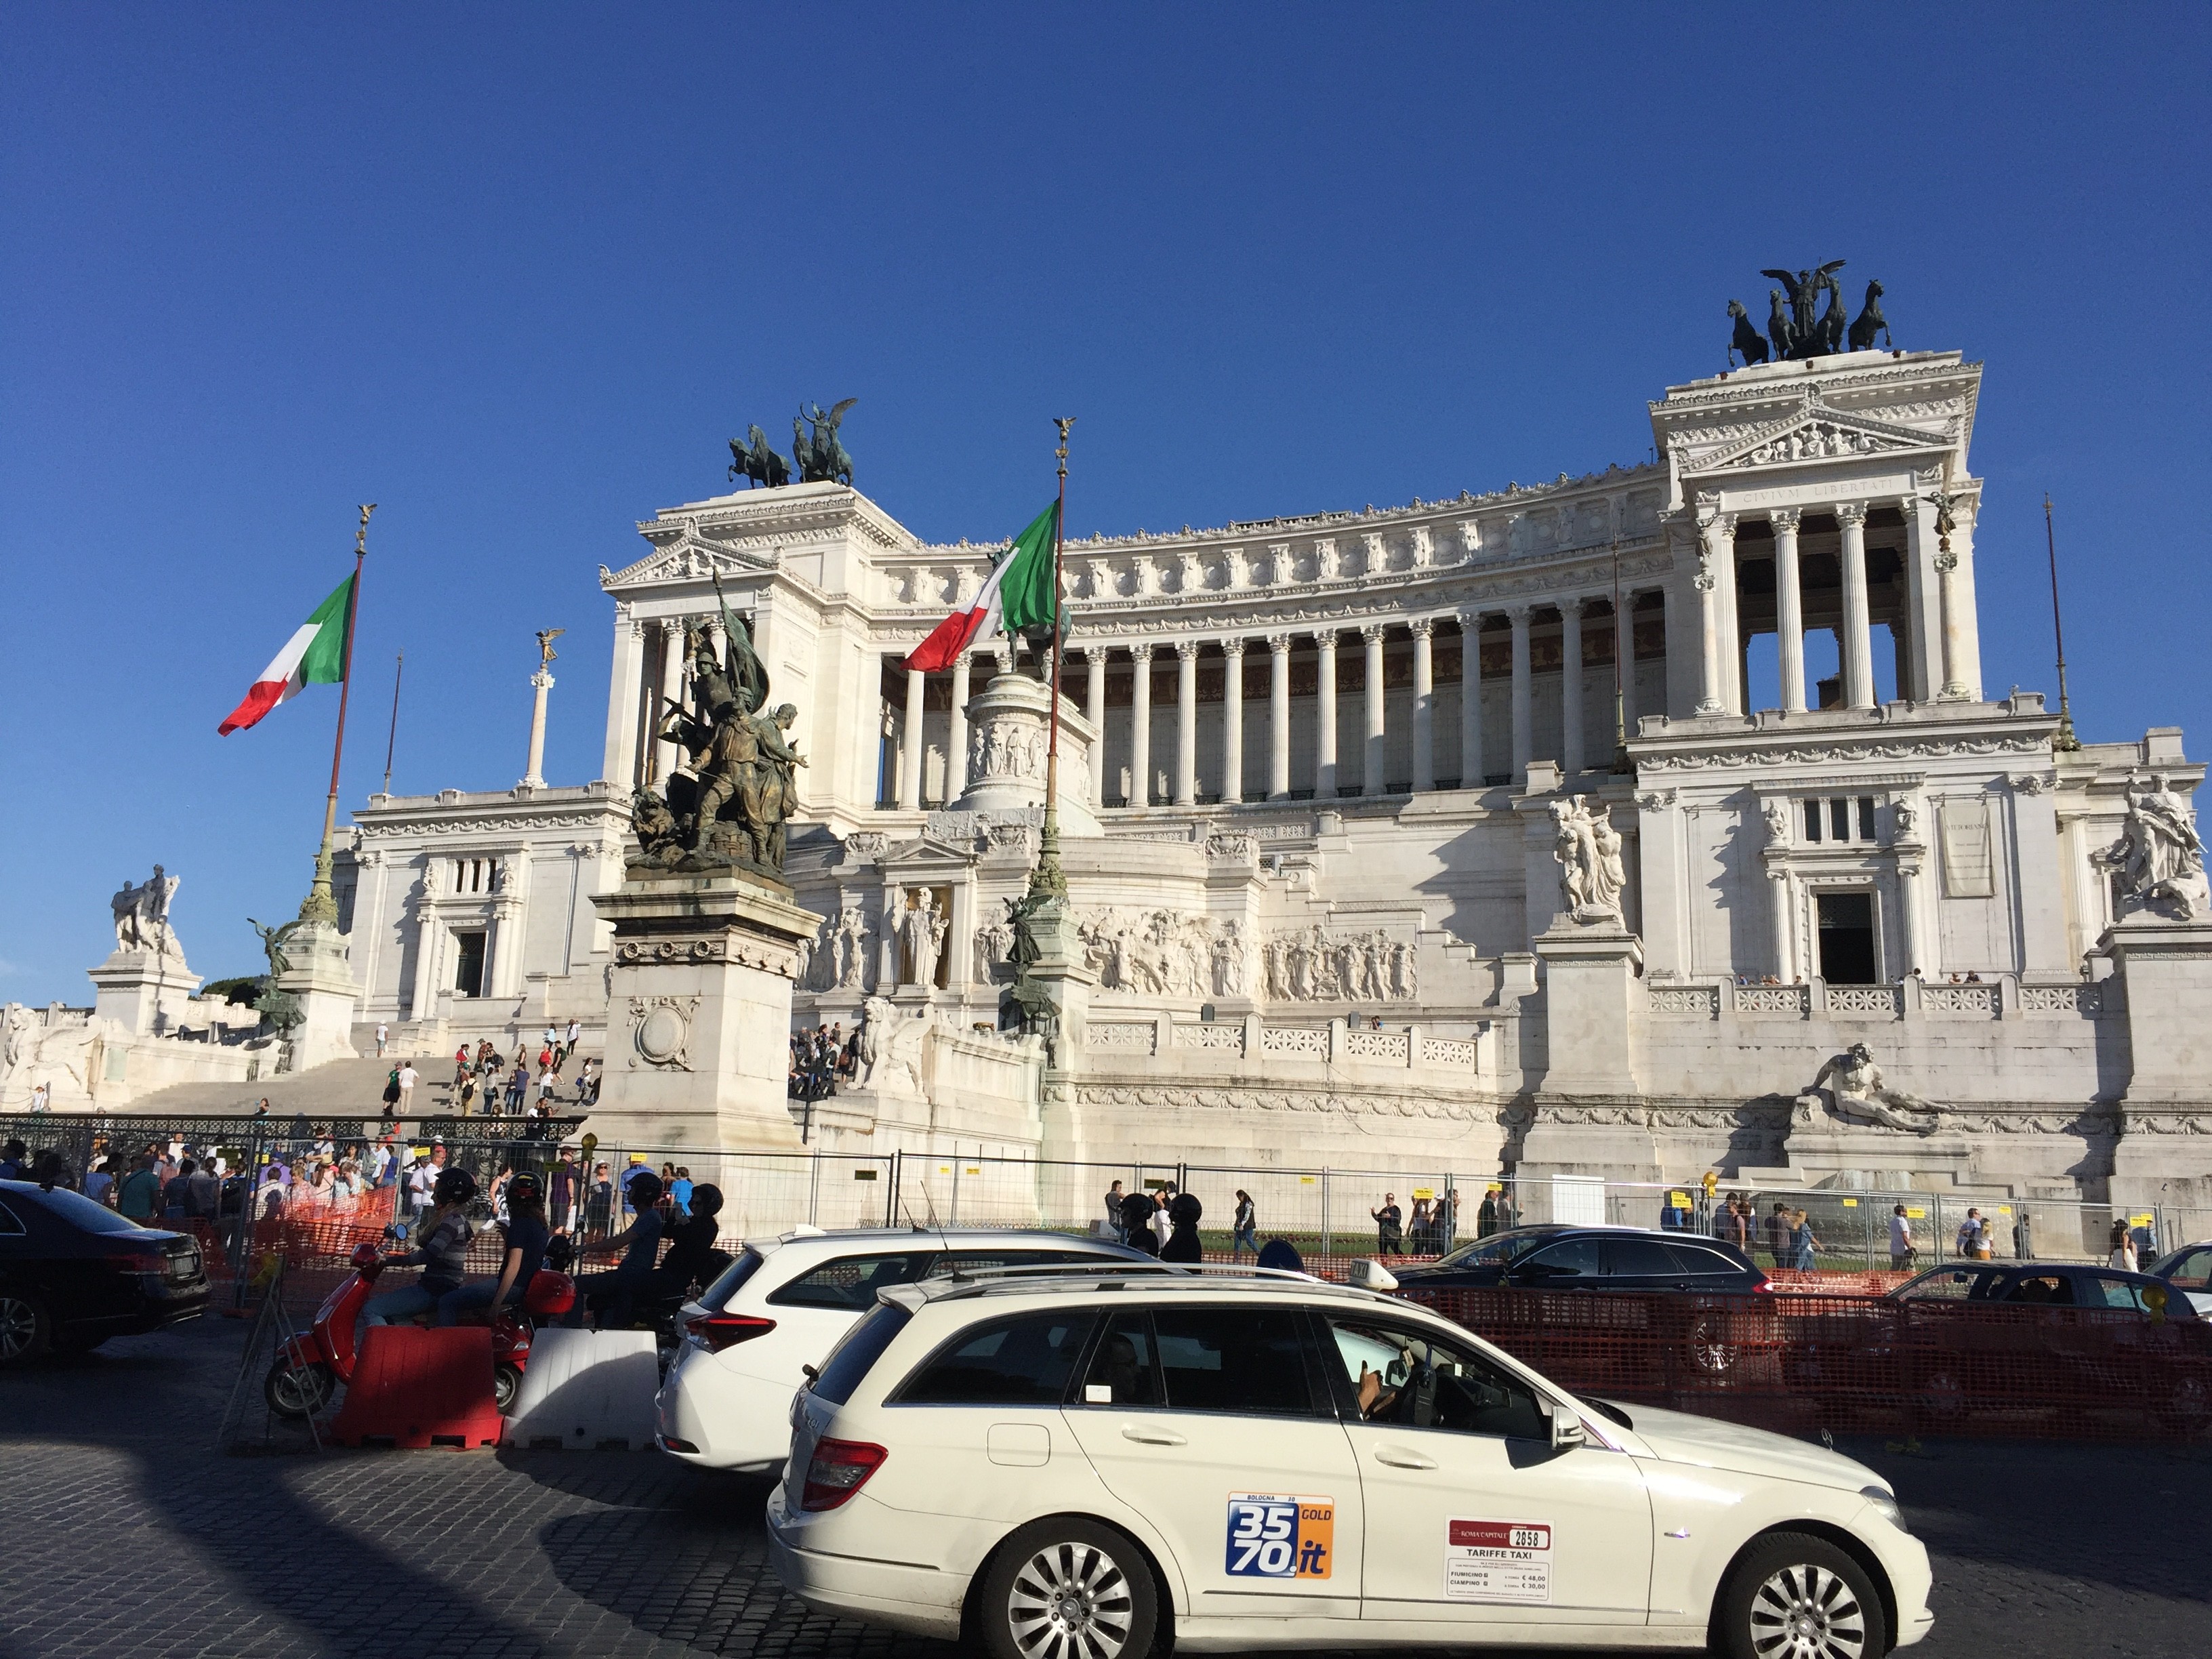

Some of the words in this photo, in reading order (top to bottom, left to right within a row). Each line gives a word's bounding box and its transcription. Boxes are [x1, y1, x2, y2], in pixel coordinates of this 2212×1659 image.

[1814, 479, 1892, 495] LIBERTATI
[1351, 1262, 1368, 1278] TAXI
[1233, 1505, 1294, 1540] 35
[1301, 1509, 1332, 1521] GOLD
[1515, 1530, 1538, 1547] 2858
[1467, 1549, 1507, 1558] TARIFFE
[1510, 1551, 1532, 1559] TAXI
